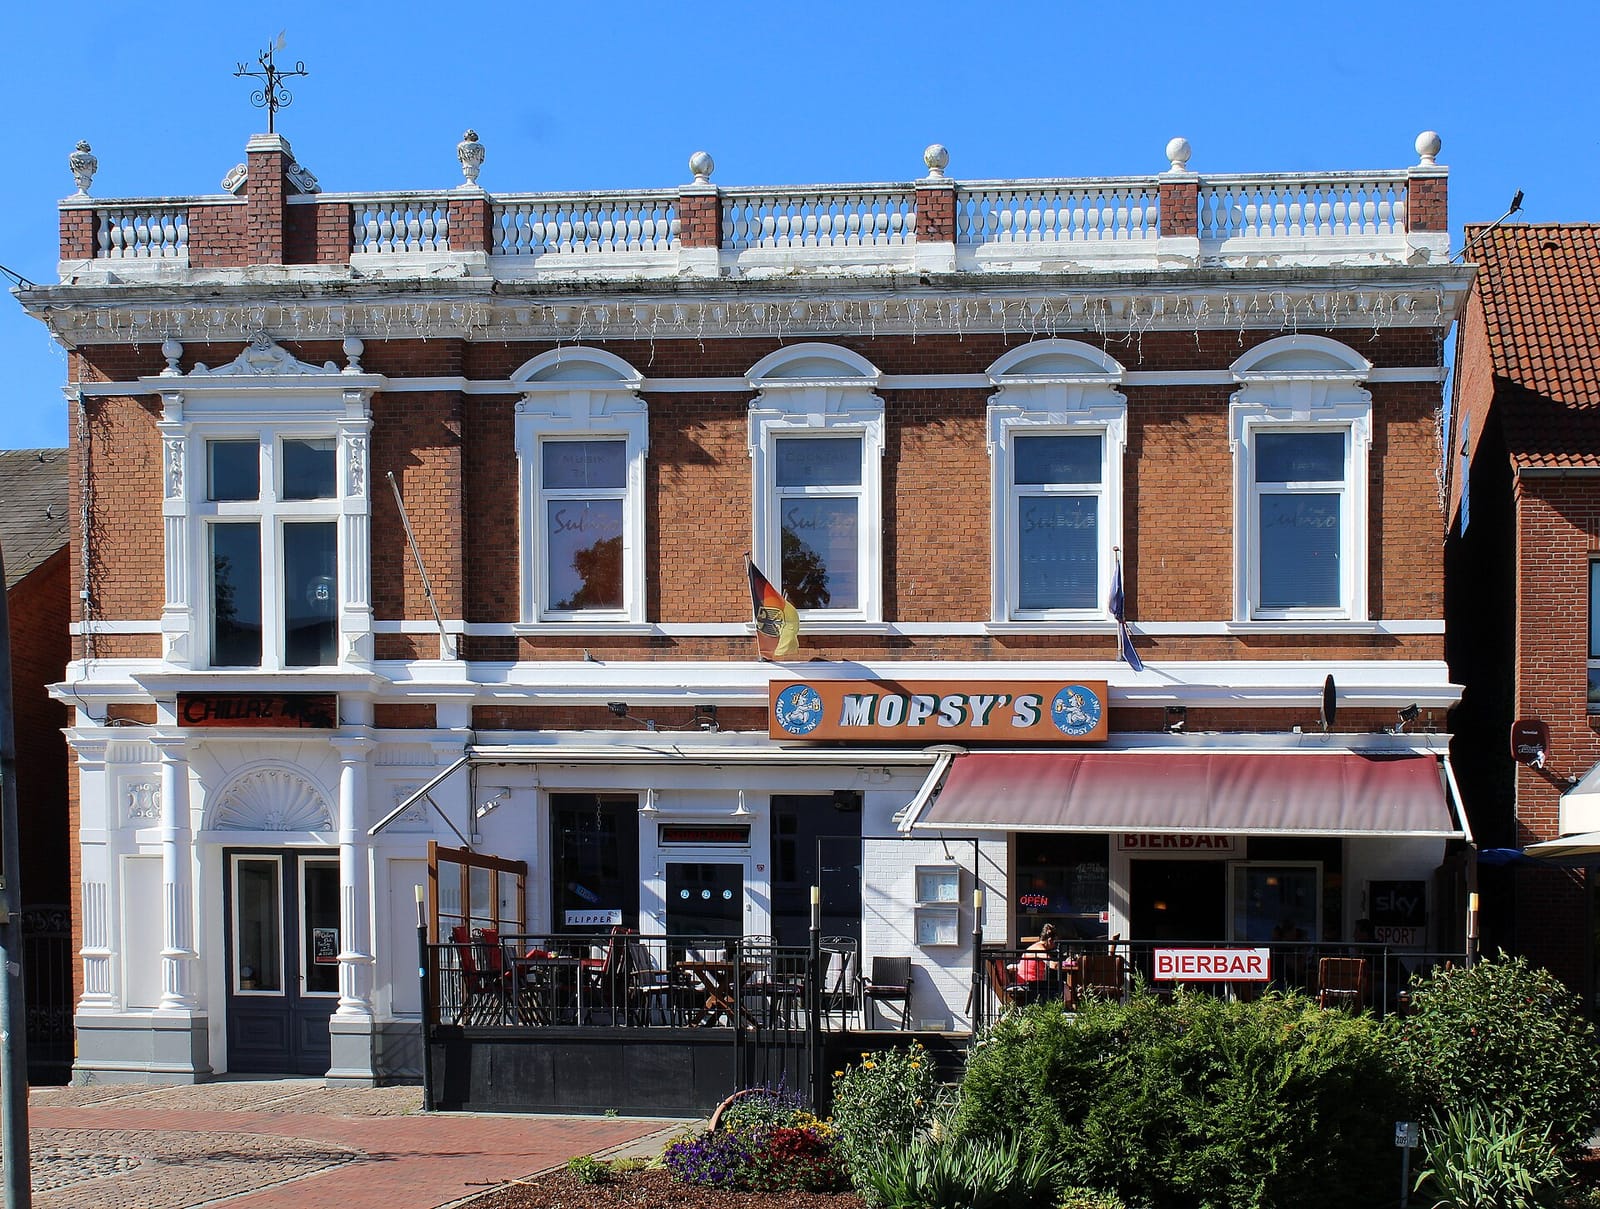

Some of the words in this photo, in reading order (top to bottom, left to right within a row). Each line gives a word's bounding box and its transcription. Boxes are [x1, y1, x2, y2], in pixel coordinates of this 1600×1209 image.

[237, 62, 248, 73] W
[776, 698, 788, 728] MOPSY
[788, 725, 800, 734] IST
[839, 694, 1043, 727] MOPSY'S
[1060, 725, 1088, 735] MOPSY
[1088, 717, 1098, 728] IST
[1020, 896, 1048, 906] OPEN
[1376, 890, 1419, 917] sky
[1377, 928, 1416, 944] SPORT
[1159, 956, 1262, 973] BIERBAR
